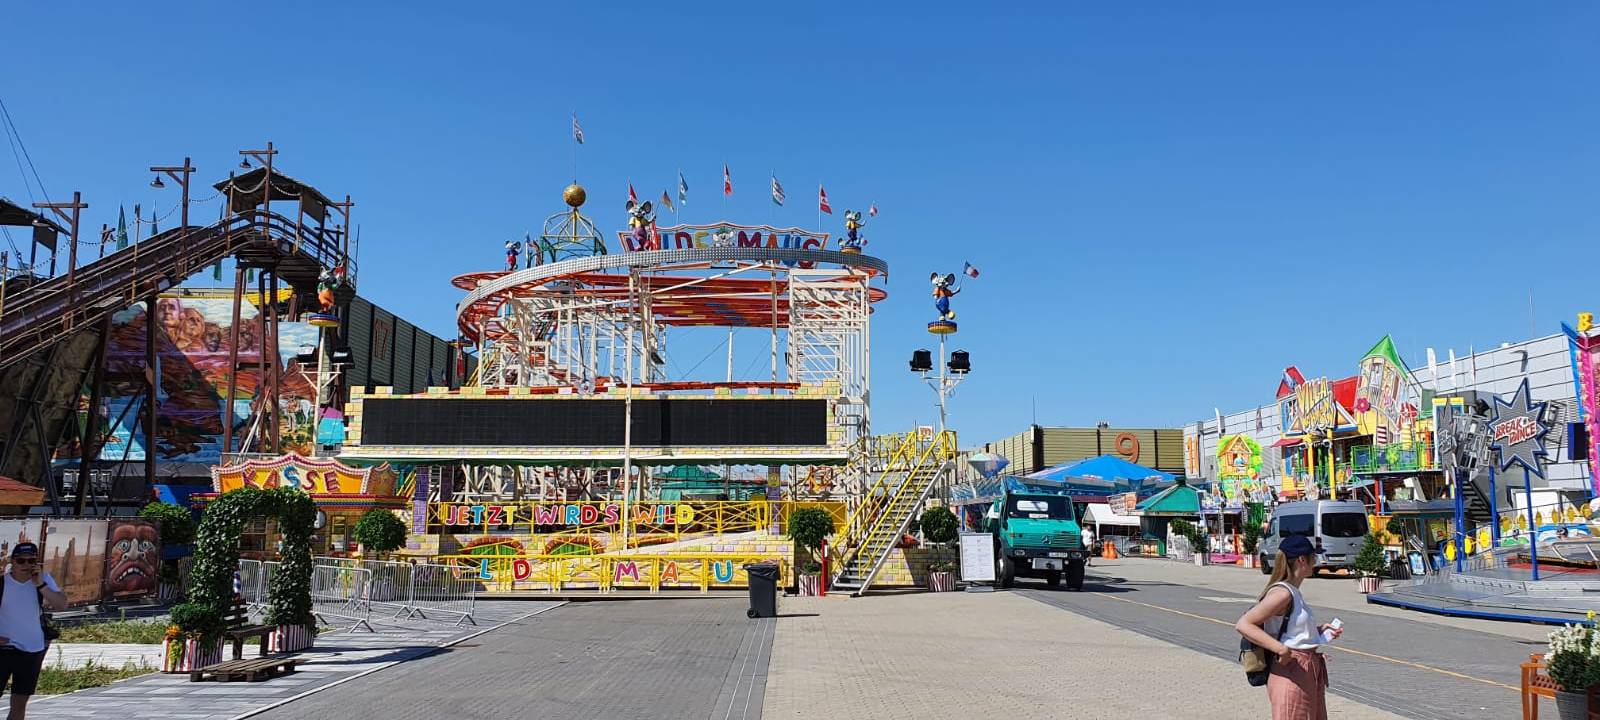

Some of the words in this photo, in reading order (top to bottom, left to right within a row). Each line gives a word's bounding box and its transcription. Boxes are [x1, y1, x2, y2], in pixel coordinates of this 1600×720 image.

[374, 319, 391, 360] 17
[1495, 416, 1524, 440] BREAK
[1508, 421, 1537, 446] DANCE
[1114, 432, 1140, 463] 9
[242, 465, 340, 493] KASSE
[445, 505, 518, 526] JETZT
[534, 503, 619, 526] WIRD'S
[633, 504, 694, 526] WILD
